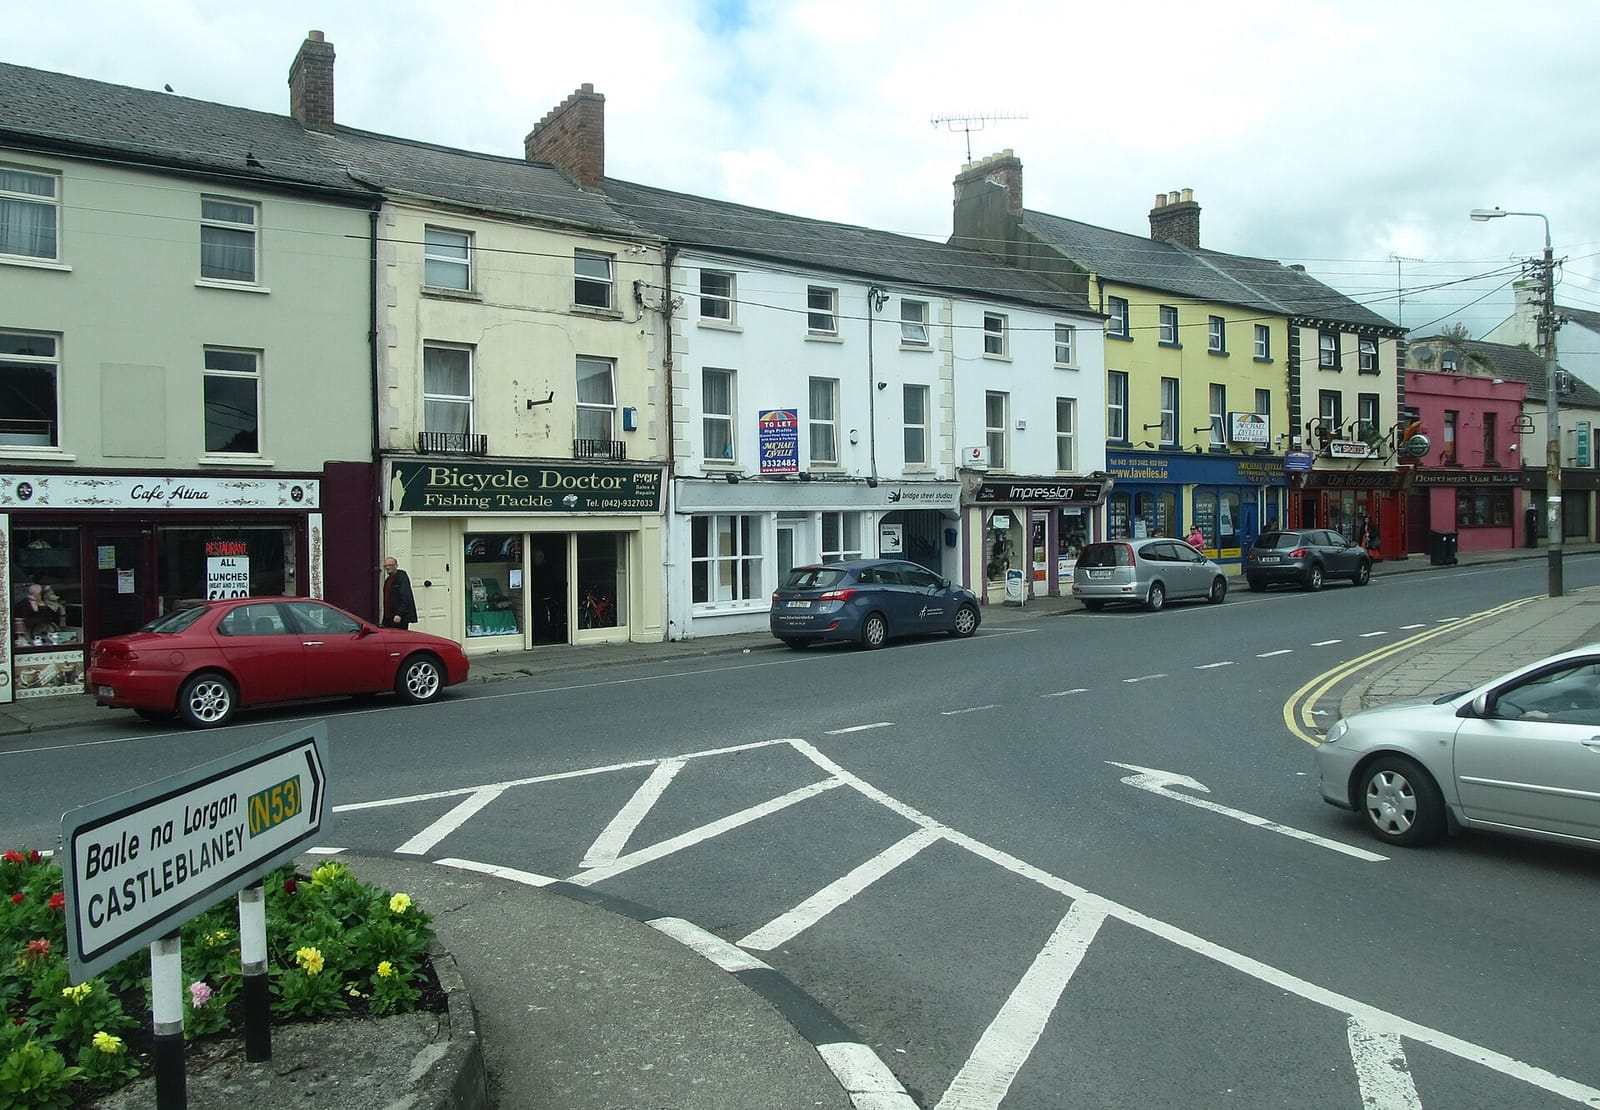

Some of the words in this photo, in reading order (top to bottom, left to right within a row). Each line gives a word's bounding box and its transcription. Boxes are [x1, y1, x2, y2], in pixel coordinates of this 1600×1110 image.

[762, 459, 797, 467] 9332482
[427, 466, 529, 493] Bicycle
[539, 470, 627, 490] Doctor
[633, 473, 659, 482] CYCLE
[169, 484, 209, 500] Atina
[902, 491, 919, 500] bridge
[936, 491, 953, 499] studios
[424, 493, 491, 509] Fishing
[497, 494, 553, 507] Tackle
[586, 499, 600, 507] Tel.
[220, 558, 236, 566] ALL
[208, 572, 248, 581] LUNCHES
[248, 777, 302, 836] (N53)
[150, 820, 174, 851] na
[183, 791, 238, 837] Lorgan
[87, 822, 246, 929] CASTLEBLANEY
